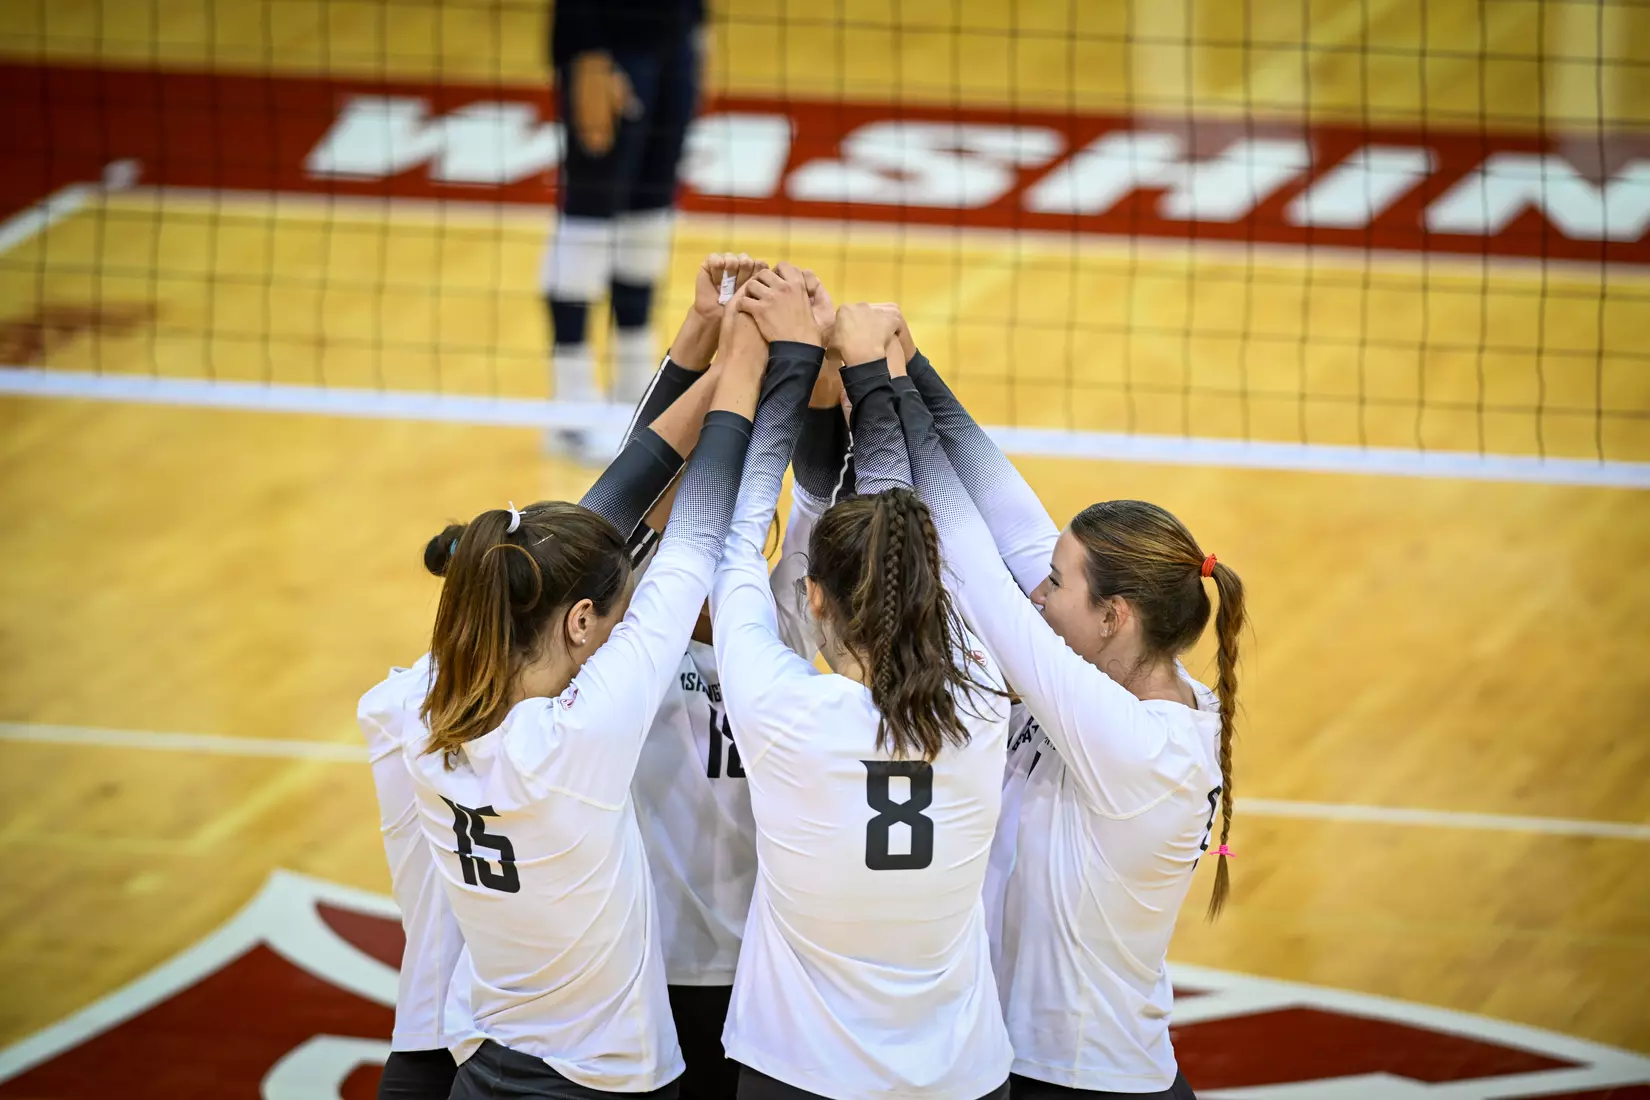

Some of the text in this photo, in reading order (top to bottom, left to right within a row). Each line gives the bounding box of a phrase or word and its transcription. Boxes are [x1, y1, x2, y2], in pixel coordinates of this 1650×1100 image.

[707, 703, 747, 778] 1
[437, 793, 521, 893] 15
[859, 759, 934, 870] 8
